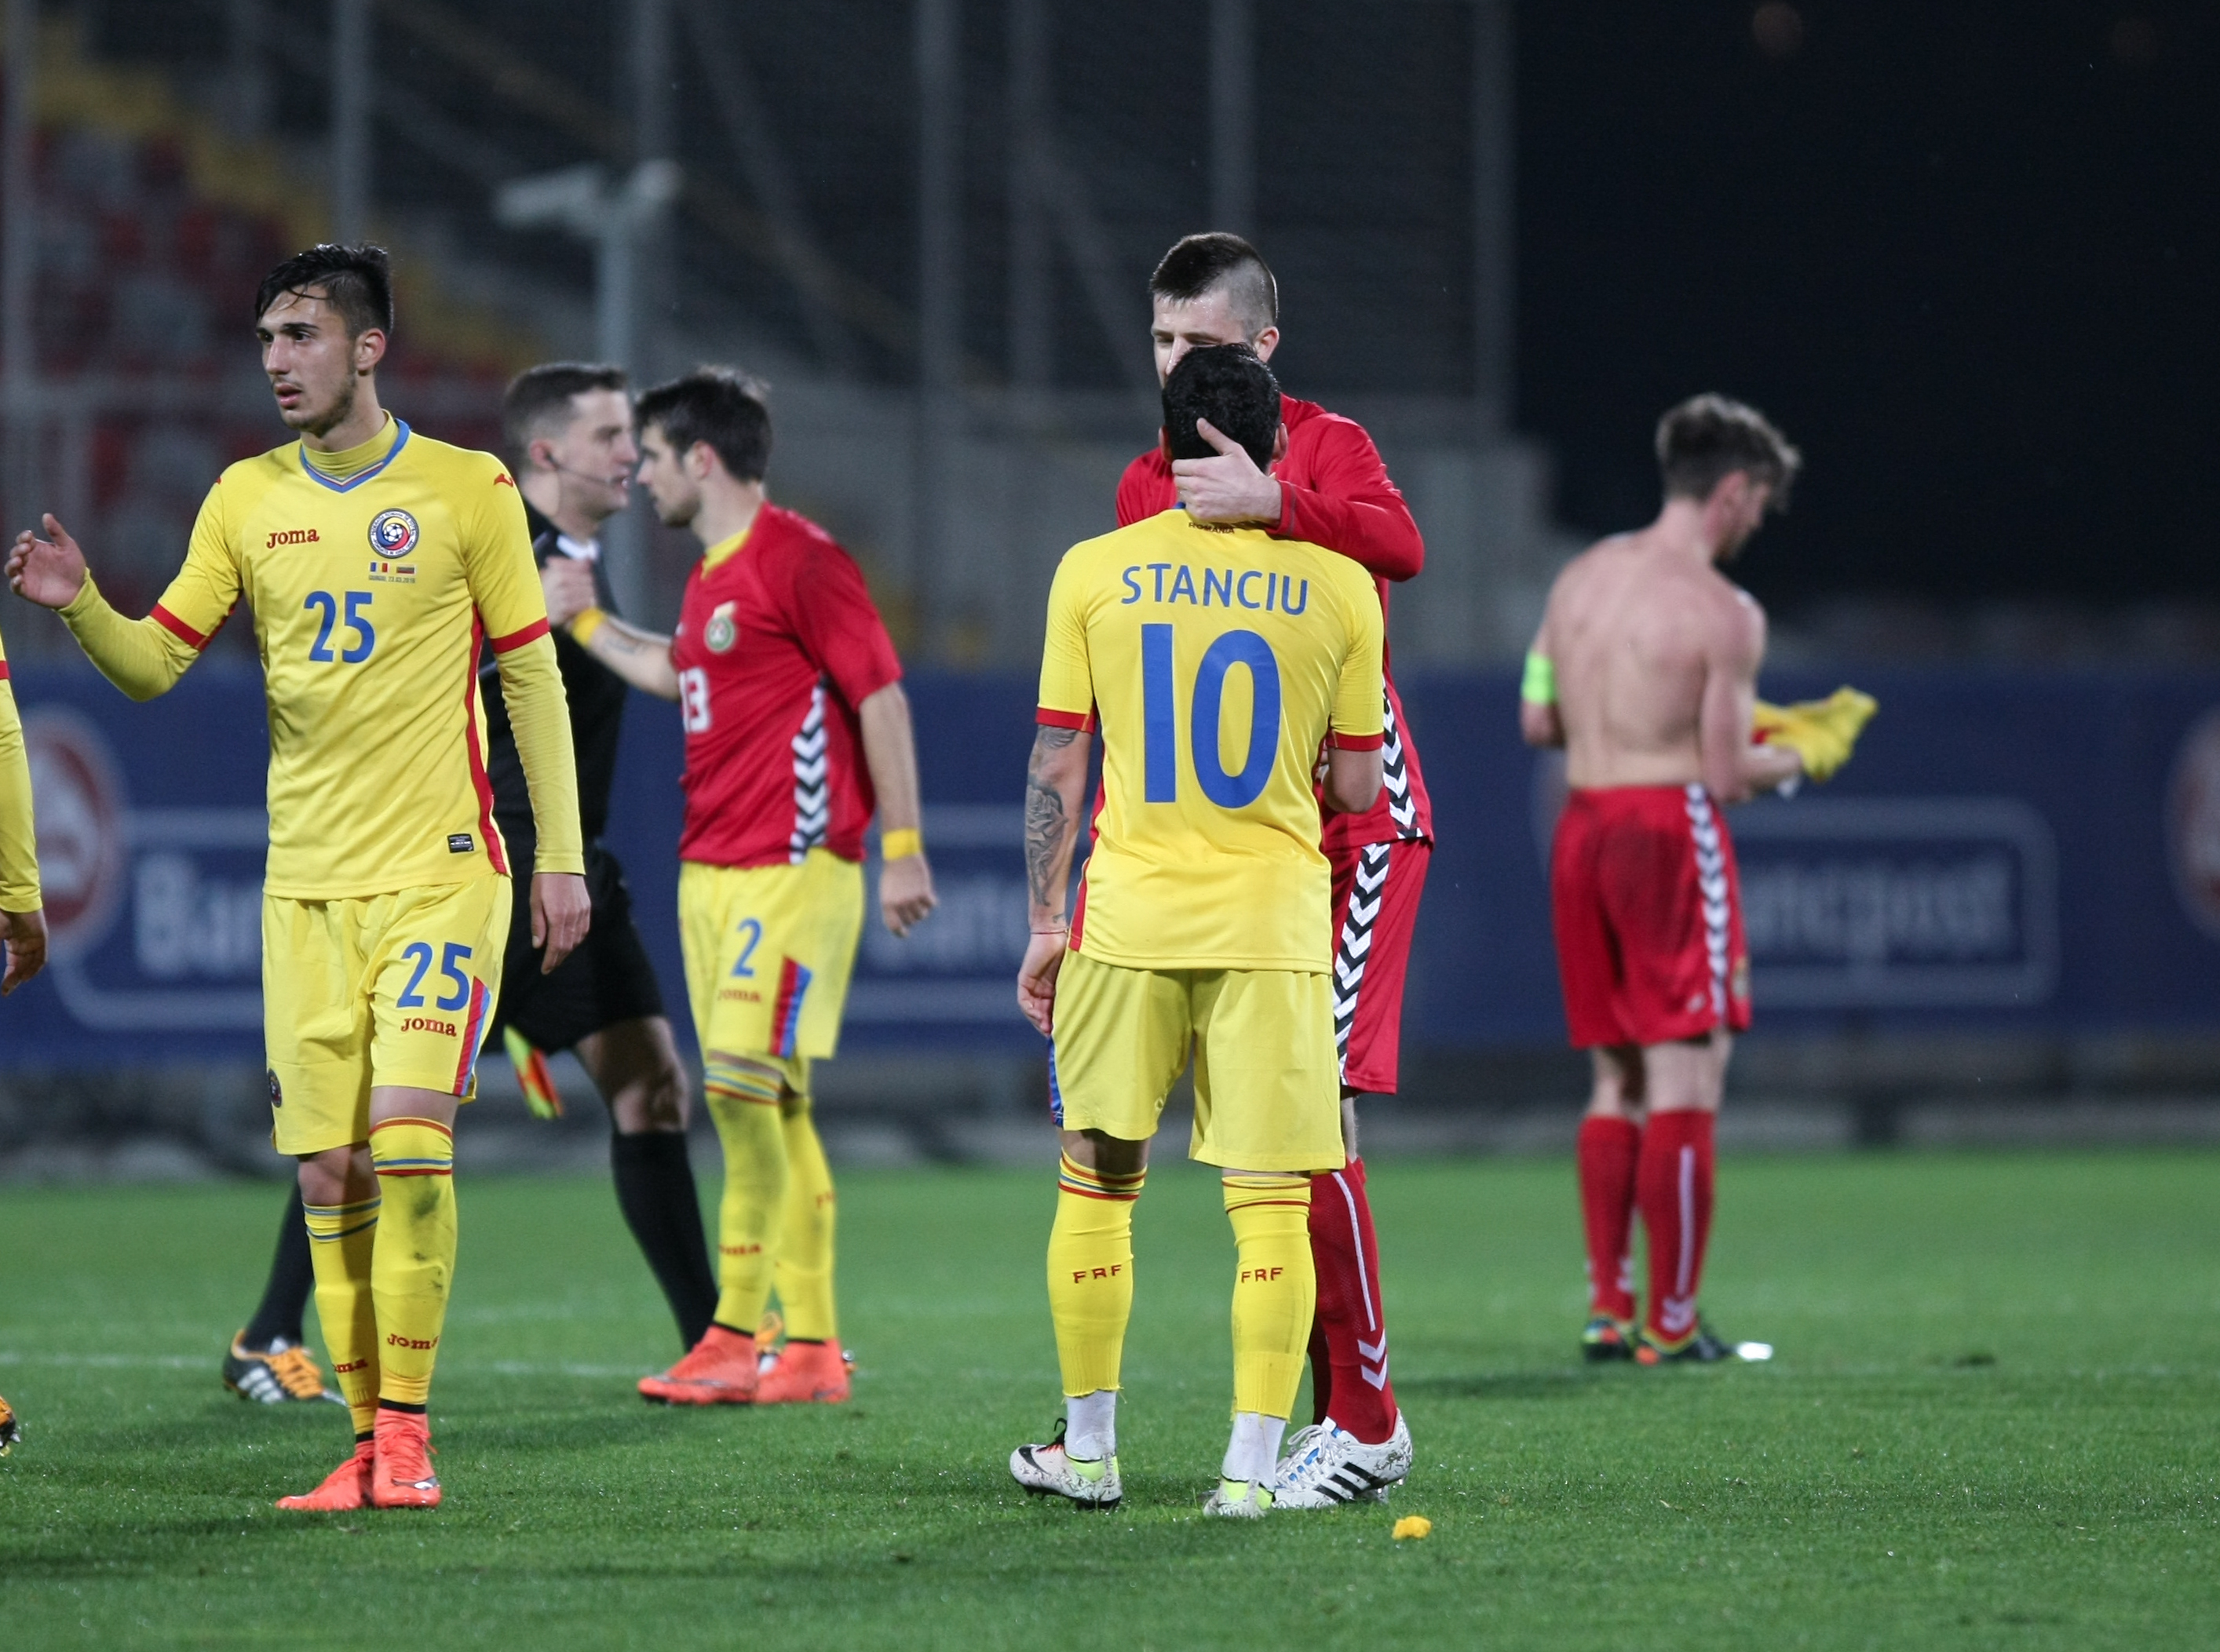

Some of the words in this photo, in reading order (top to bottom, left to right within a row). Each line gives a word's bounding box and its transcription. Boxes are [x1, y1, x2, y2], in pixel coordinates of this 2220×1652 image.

[266, 528, 320, 549] Joma
[1121, 563, 1308, 615] STANCIU
[304, 591, 375, 664] 25
[1141, 623, 1281, 808] 10
[729, 917, 762, 978] 2
[396, 942, 473, 1012] 25
[400, 1017, 457, 1037] Joma
[1072, 1264, 1123, 1284] FRF
[1241, 1267, 1284, 1283] FRF
